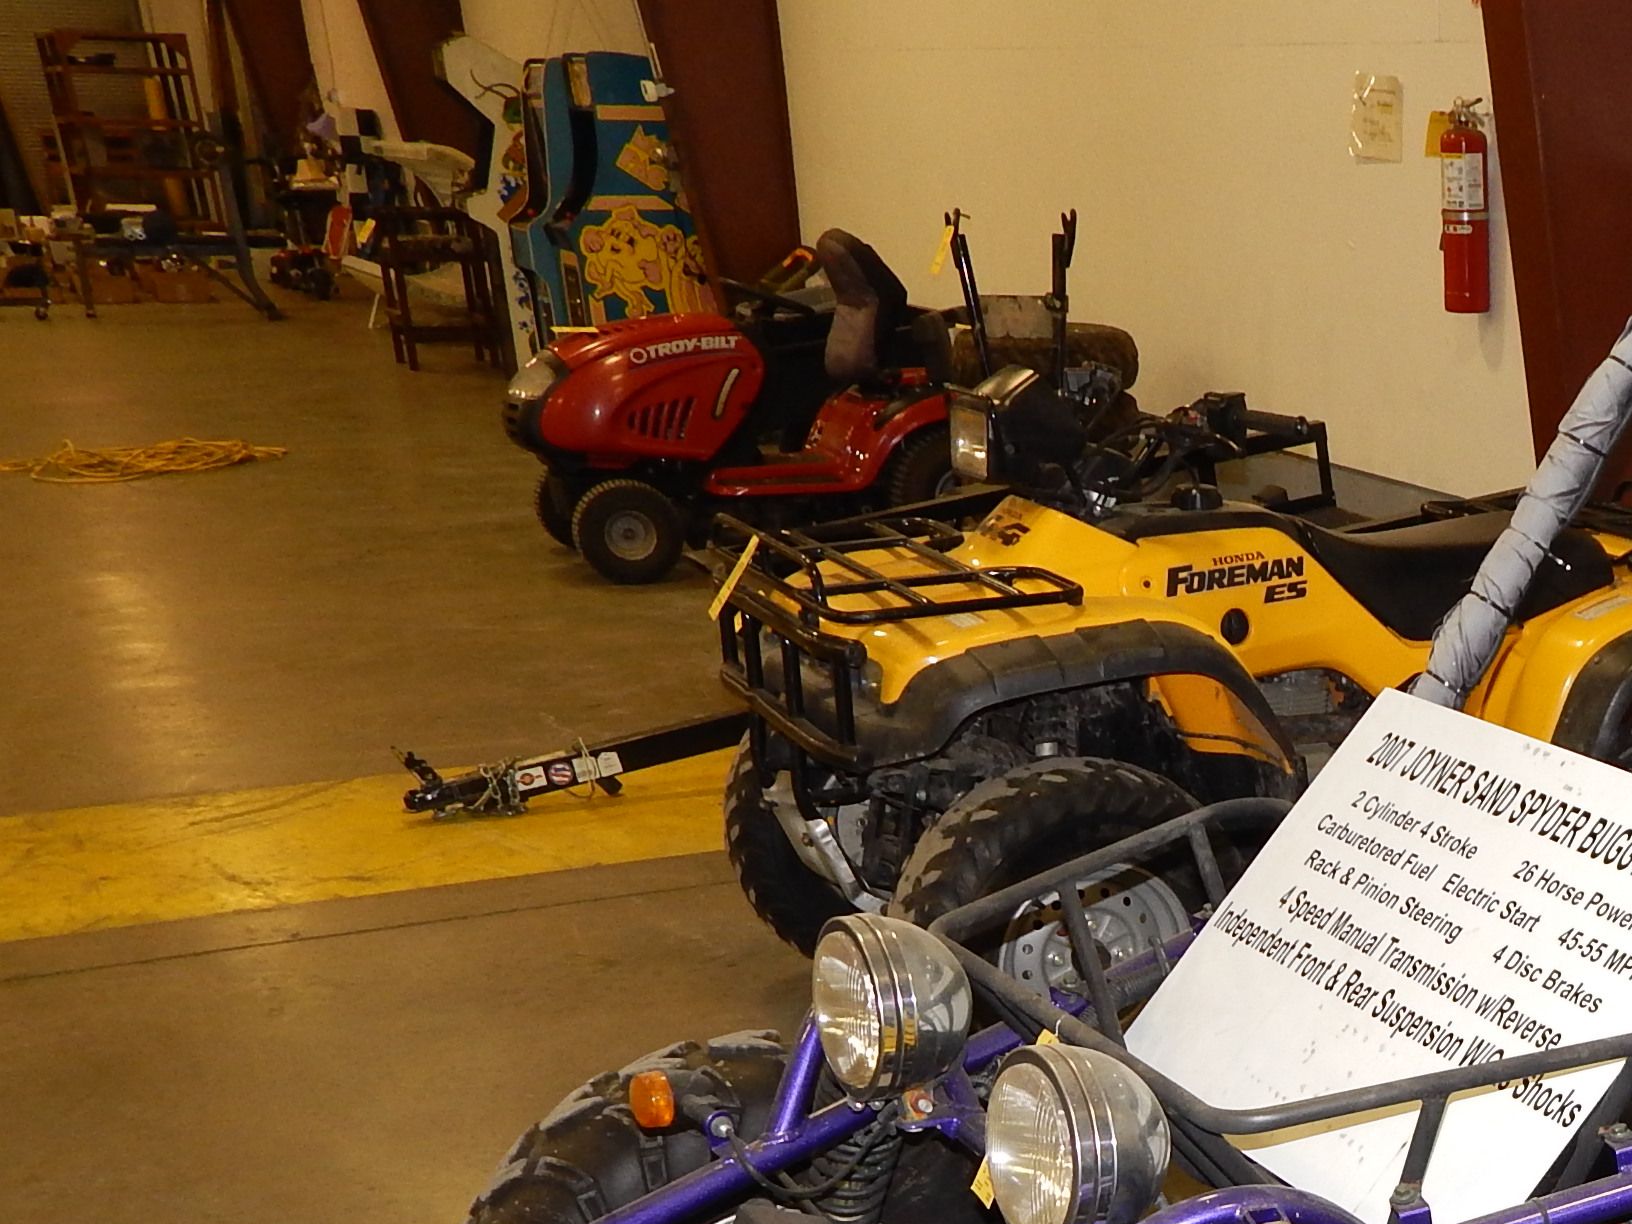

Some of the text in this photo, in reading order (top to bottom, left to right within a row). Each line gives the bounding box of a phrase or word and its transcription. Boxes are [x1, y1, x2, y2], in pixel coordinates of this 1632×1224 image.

[645, 336, 739, 360] TROY-BILT
[1166, 556, 1304, 598] FOREMAN
[1212, 551, 1265, 567] HONDA
[1263, 580, 1308, 604] ES
[1351, 790, 1367, 808] 2
[1363, 795, 1421, 834] Cylinder
[1419, 821, 1434, 839] 4
[1430, 825, 1479, 860] Stroke
[1512, 860, 1539, 882] 26
[1534, 868, 1584, 905] Horse
[1366, 732, 1416, 772] 2007
[1400, 745, 1477, 800] JOYNER
[1462, 770, 1522, 817] SAND
[1508, 789, 1592, 848] SPYDER
[1303, 849, 1603, 1014] Rack & Pinion Steering 4 Disc Brakes
[1317, 814, 1407, 867] Carburetored
[1400, 853, 1439, 882] Fuel
[1441, 873, 1500, 914] Electric
[1499, 900, 1542, 933] Start
[1557, 927, 1609, 963] 45-55
[1213, 901, 1583, 1128] Independent Front & Rear Suspension Shocks
[1278, 885, 1563, 1053] 4 Speed Manual Transmission w/Reverse
